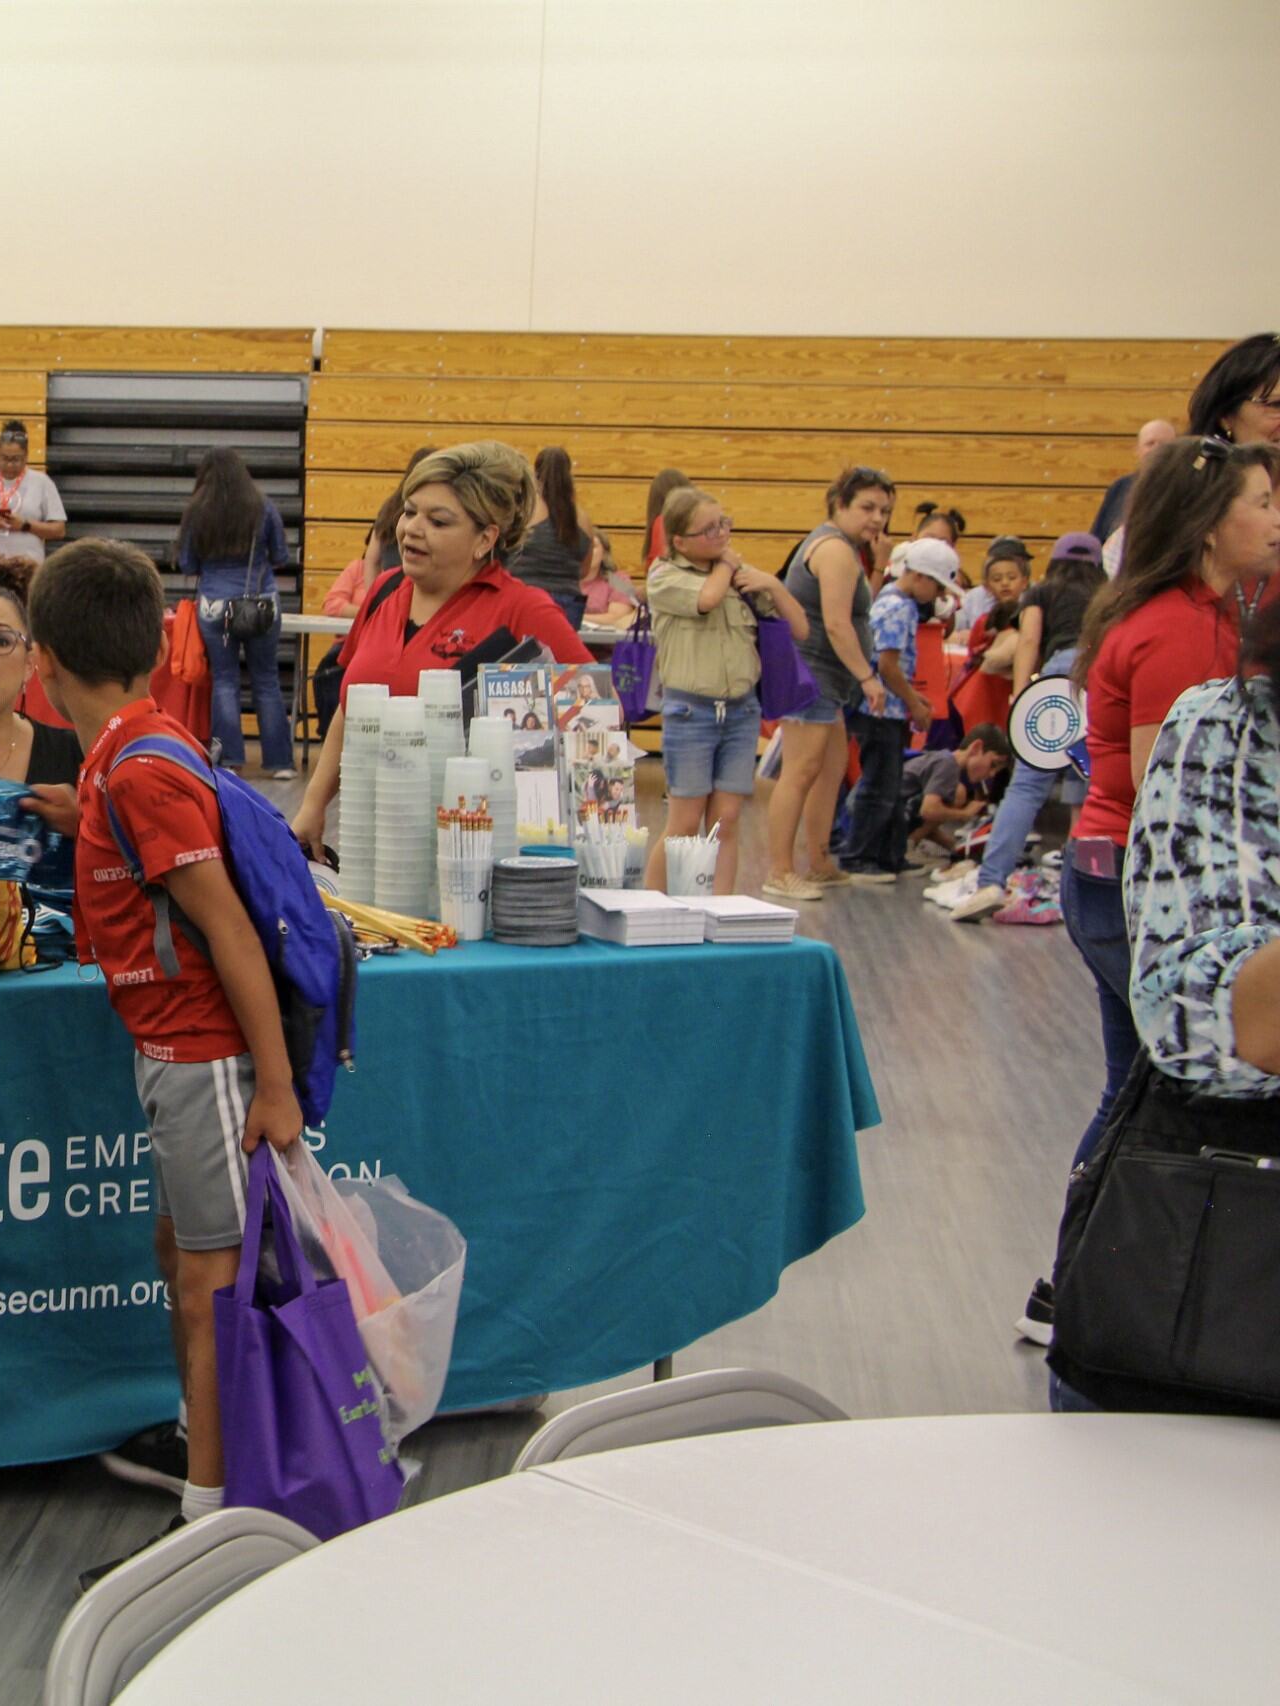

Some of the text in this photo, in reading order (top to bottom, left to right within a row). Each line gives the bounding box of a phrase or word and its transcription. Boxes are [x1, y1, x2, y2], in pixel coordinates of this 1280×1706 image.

[488, 681, 533, 697] KASASA
[112, 967, 155, 987] LEGEND
[142, 1040, 175, 1061] LEGEND
